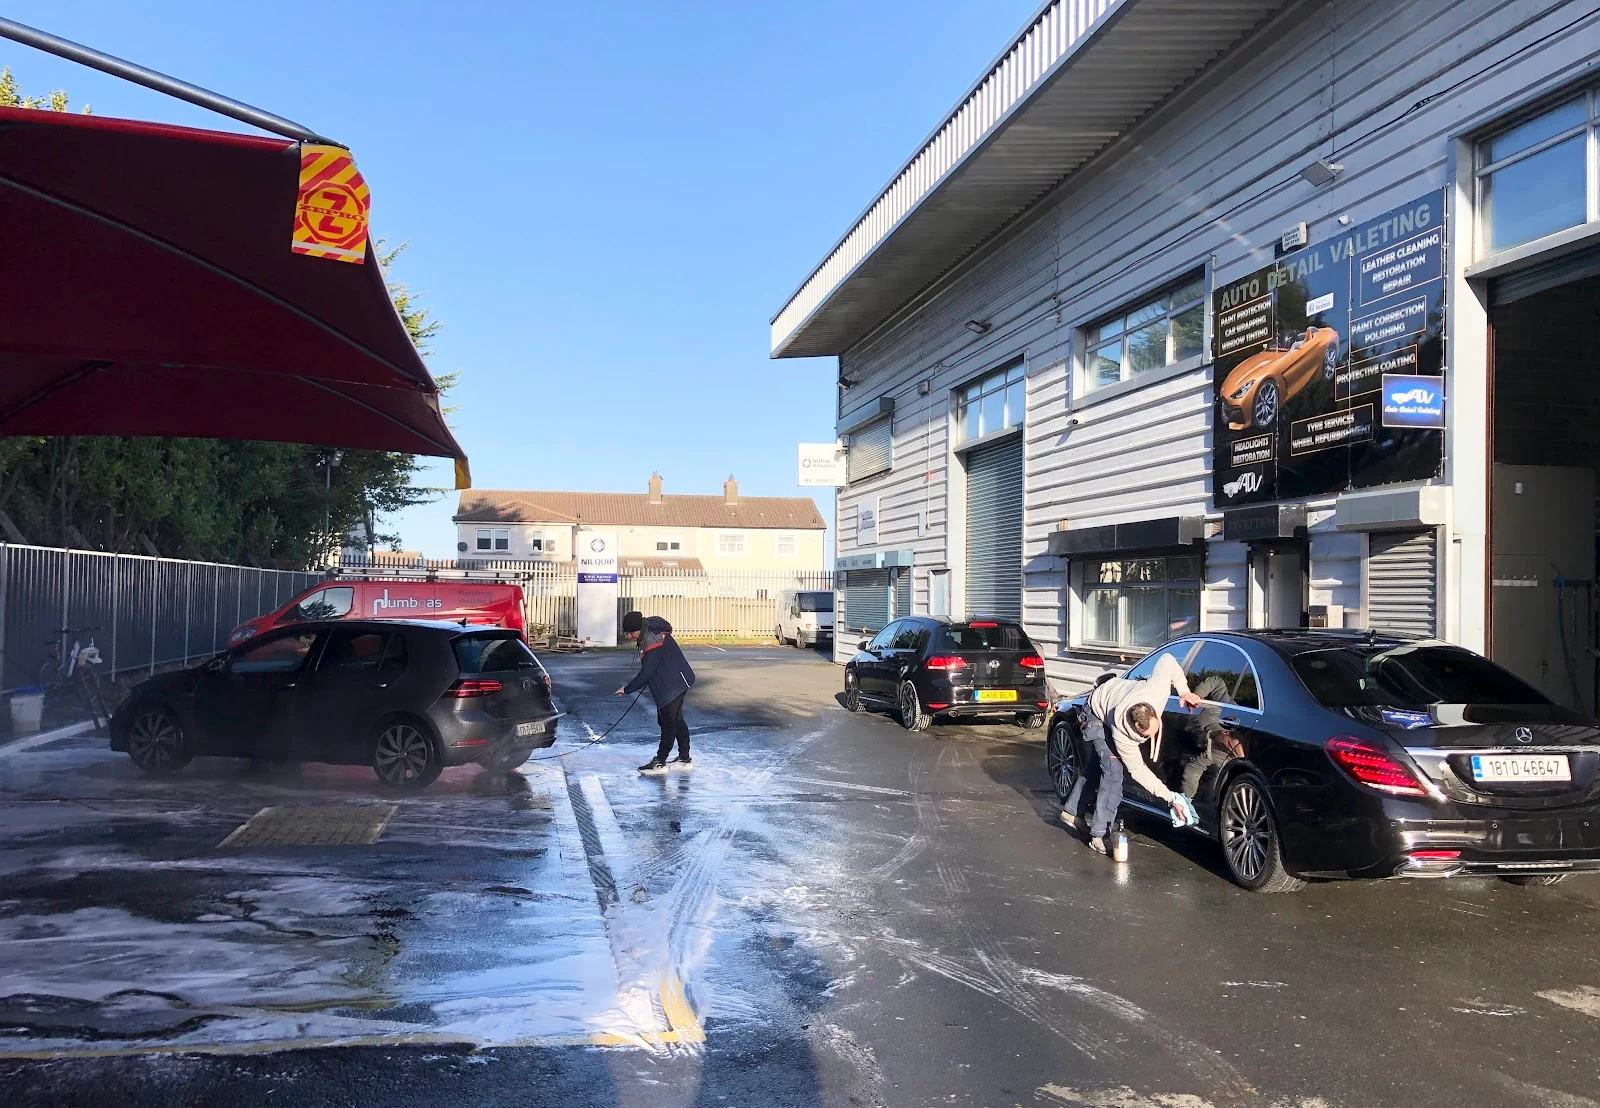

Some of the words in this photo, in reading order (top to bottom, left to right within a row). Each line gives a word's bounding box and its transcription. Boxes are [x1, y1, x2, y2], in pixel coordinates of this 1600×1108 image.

[1220, 279, 1260, 310] AUTO
[1266, 252, 1324, 292] DETAIL
[1330, 204, 1430, 263] VALETING
[1362, 252, 1396, 273] LEATHER
[1396, 234, 1439, 259] CLEANING
[1372, 254, 1426, 283] RESTORATION
[1383, 274, 1412, 292] REPAIR
[1221, 313, 1237, 327] PAINT
[1236, 300, 1271, 320] PROTECTION
[1351, 319, 1374, 335] PAINT
[1374, 301, 1425, 327] CORRECTION
[1225, 326, 1236, 337] CAR
[1236, 315, 1267, 332] WRAPPING
[1364, 322, 1405, 343] POLISHING
[1221, 335, 1246, 350] WINDOW
[1246, 327, 1269, 342] TINTING
[1336, 364, 1379, 384] PROTECTIVE
[1379, 353, 1416, 372] COATING
[1307, 420, 1324, 432] TYRE
[1324, 413, 1355, 429] SERVICES
[1234, 437, 1269, 452] HEADLIGHTS
[1292, 436, 1314, 449] WHEEL
[1314, 424, 1371, 445] REFURBISHMENT
[1232, 449, 1271, 465] RESTORATION
